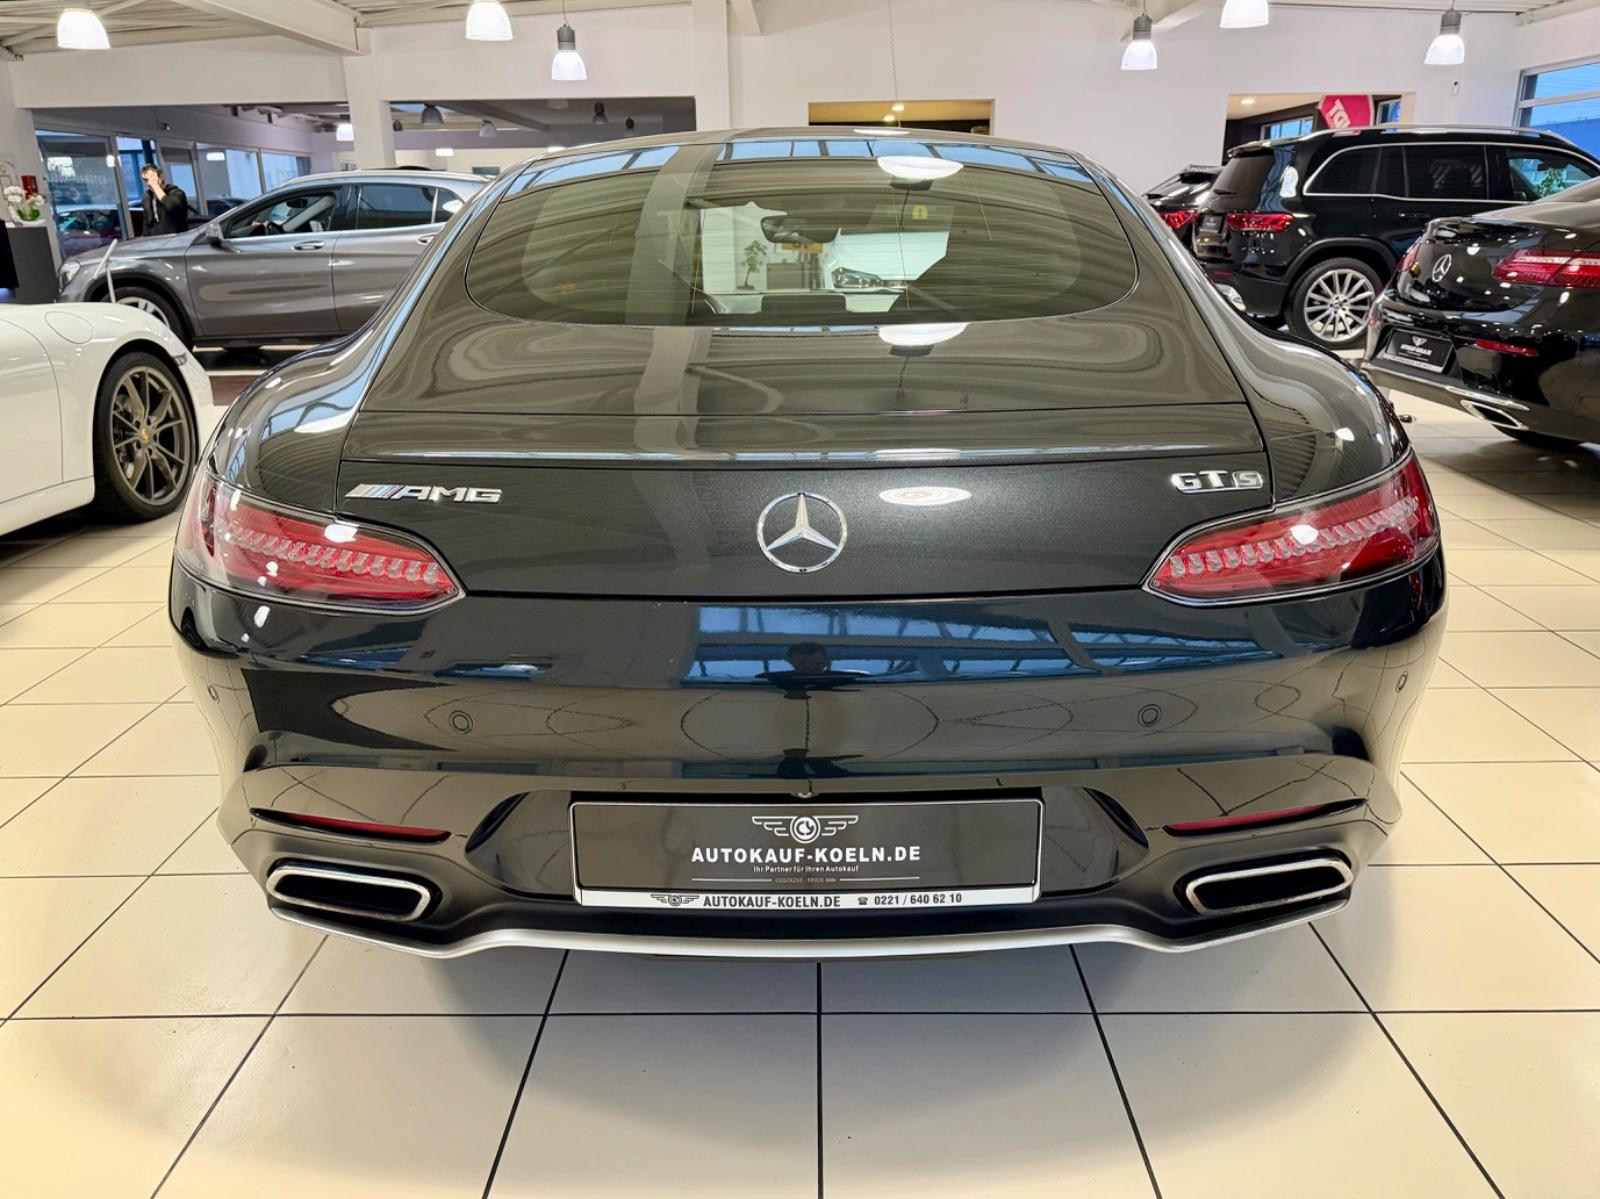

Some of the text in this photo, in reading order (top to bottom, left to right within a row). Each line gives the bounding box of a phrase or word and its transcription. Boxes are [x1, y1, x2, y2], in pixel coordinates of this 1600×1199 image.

[390, 484, 502, 503] AMG
[691, 846, 921, 864] AUTOKAUF-KOELN.DE
[703, 896, 841, 908] AUTOKAUF-KOELN.DE
[874, 895, 900, 906] 0221
[910, 894, 930, 905] 640
[932, 894, 946, 904] 62
[950, 893, 962, 903] 10
